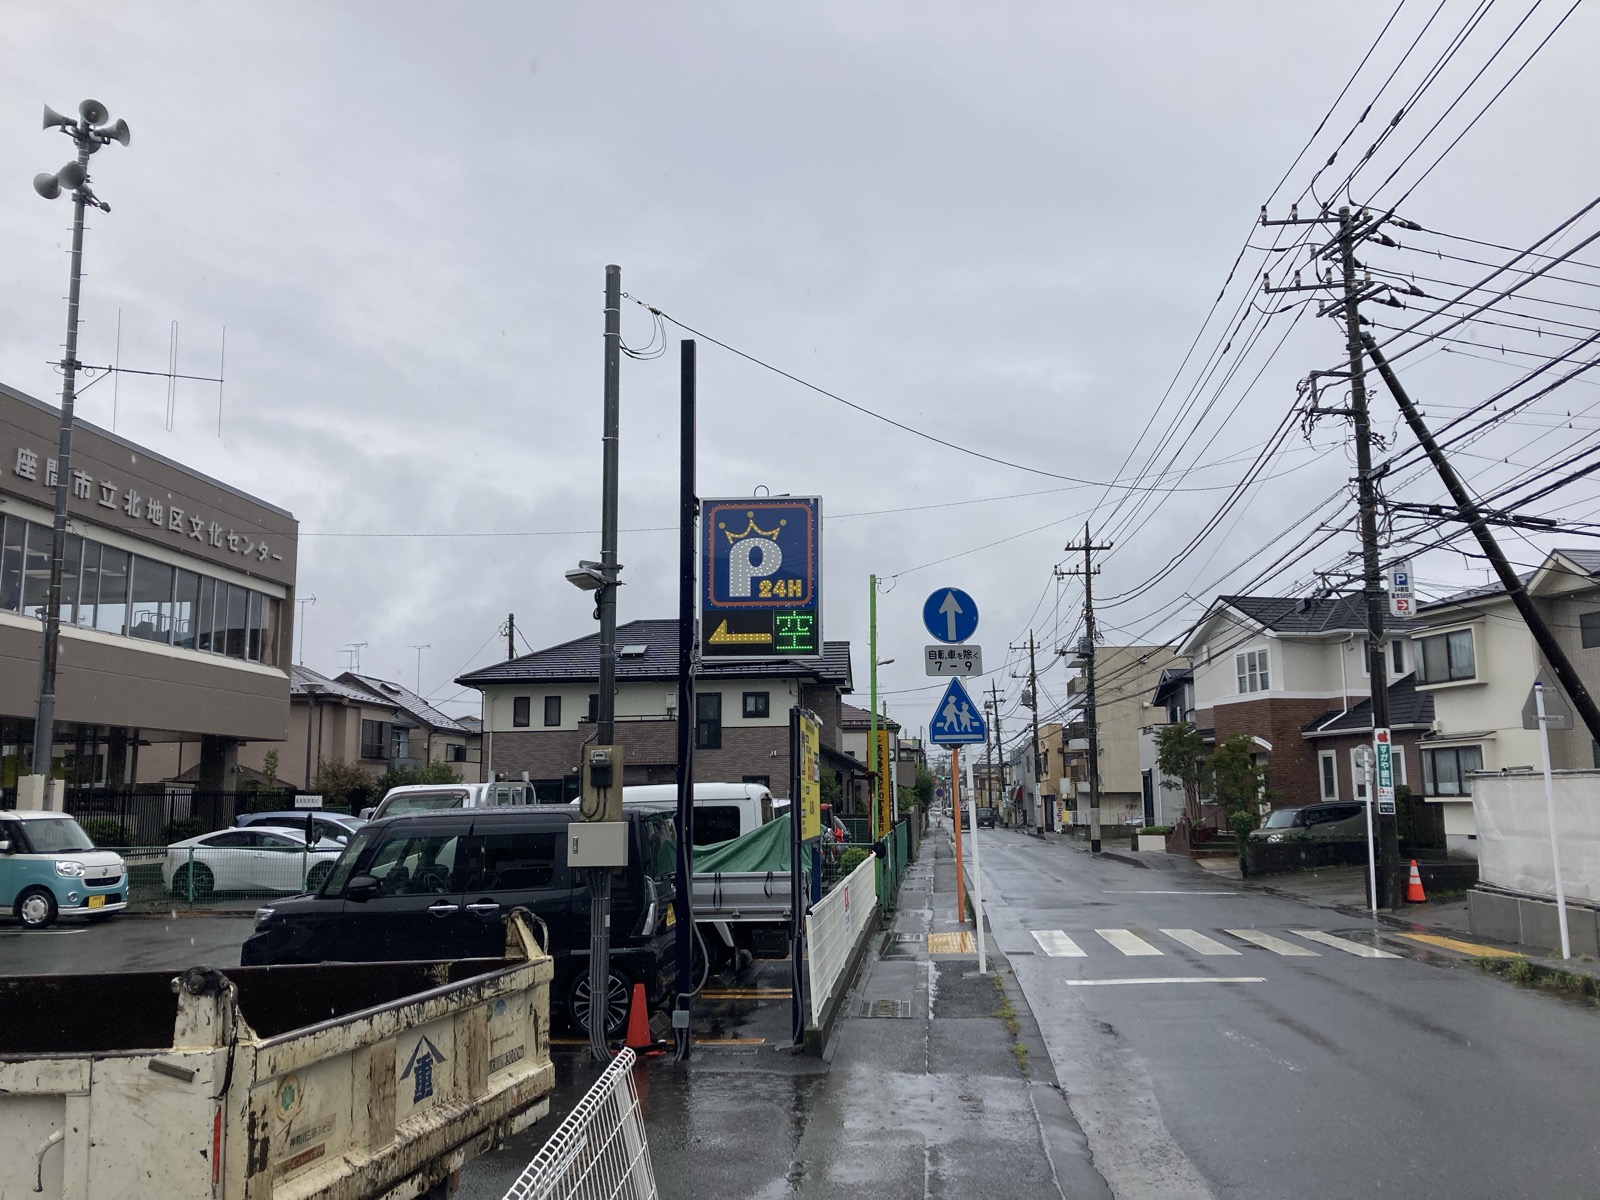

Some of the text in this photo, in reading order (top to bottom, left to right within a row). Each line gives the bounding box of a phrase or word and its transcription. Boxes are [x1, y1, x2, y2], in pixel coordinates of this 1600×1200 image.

[729, 538, 782, 597] P
[1396, 573, 1406, 585] P
[759, 579, 802, 598] 24H
[776, 610, 813, 650] 空
[928, 649, 979, 660] 自転車を除く
[1379, 745, 1391, 787] すがや歯科
